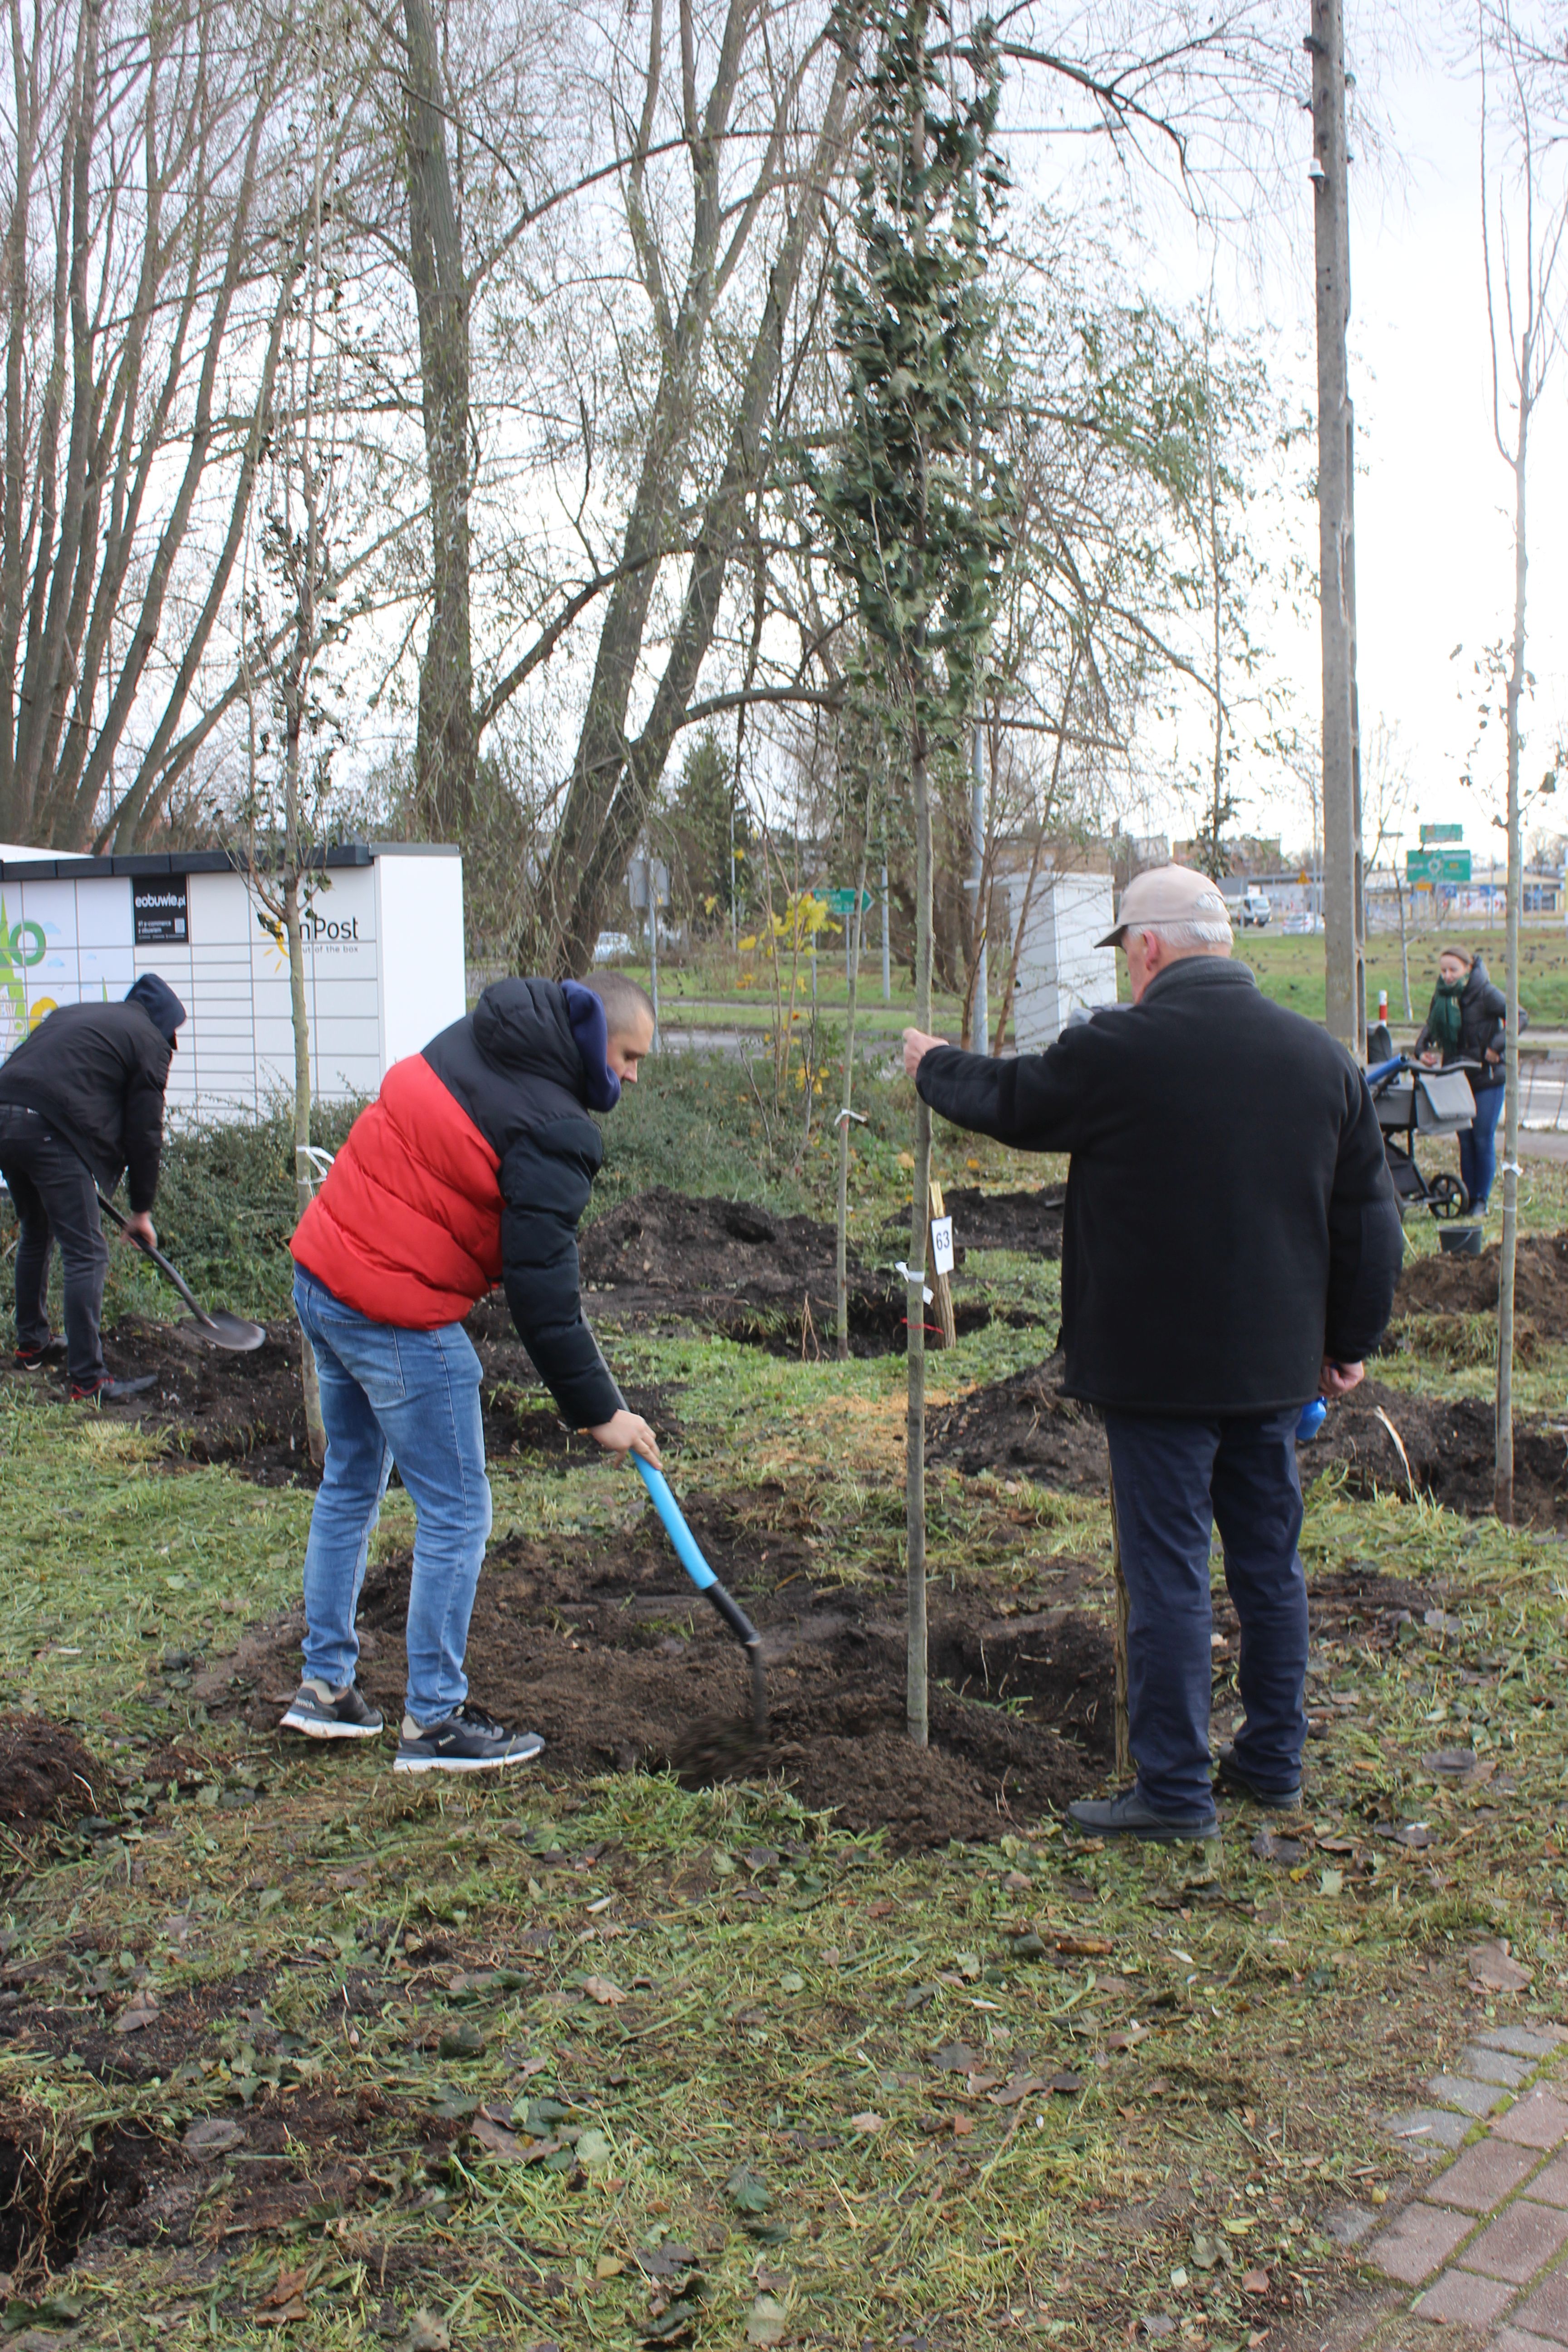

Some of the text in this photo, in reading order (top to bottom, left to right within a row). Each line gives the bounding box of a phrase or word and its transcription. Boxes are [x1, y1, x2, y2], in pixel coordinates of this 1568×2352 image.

[135, 892, 186, 909] eobuwie.pl
[299, 916, 358, 940] nPost
[936, 1230, 950, 1251] 63
